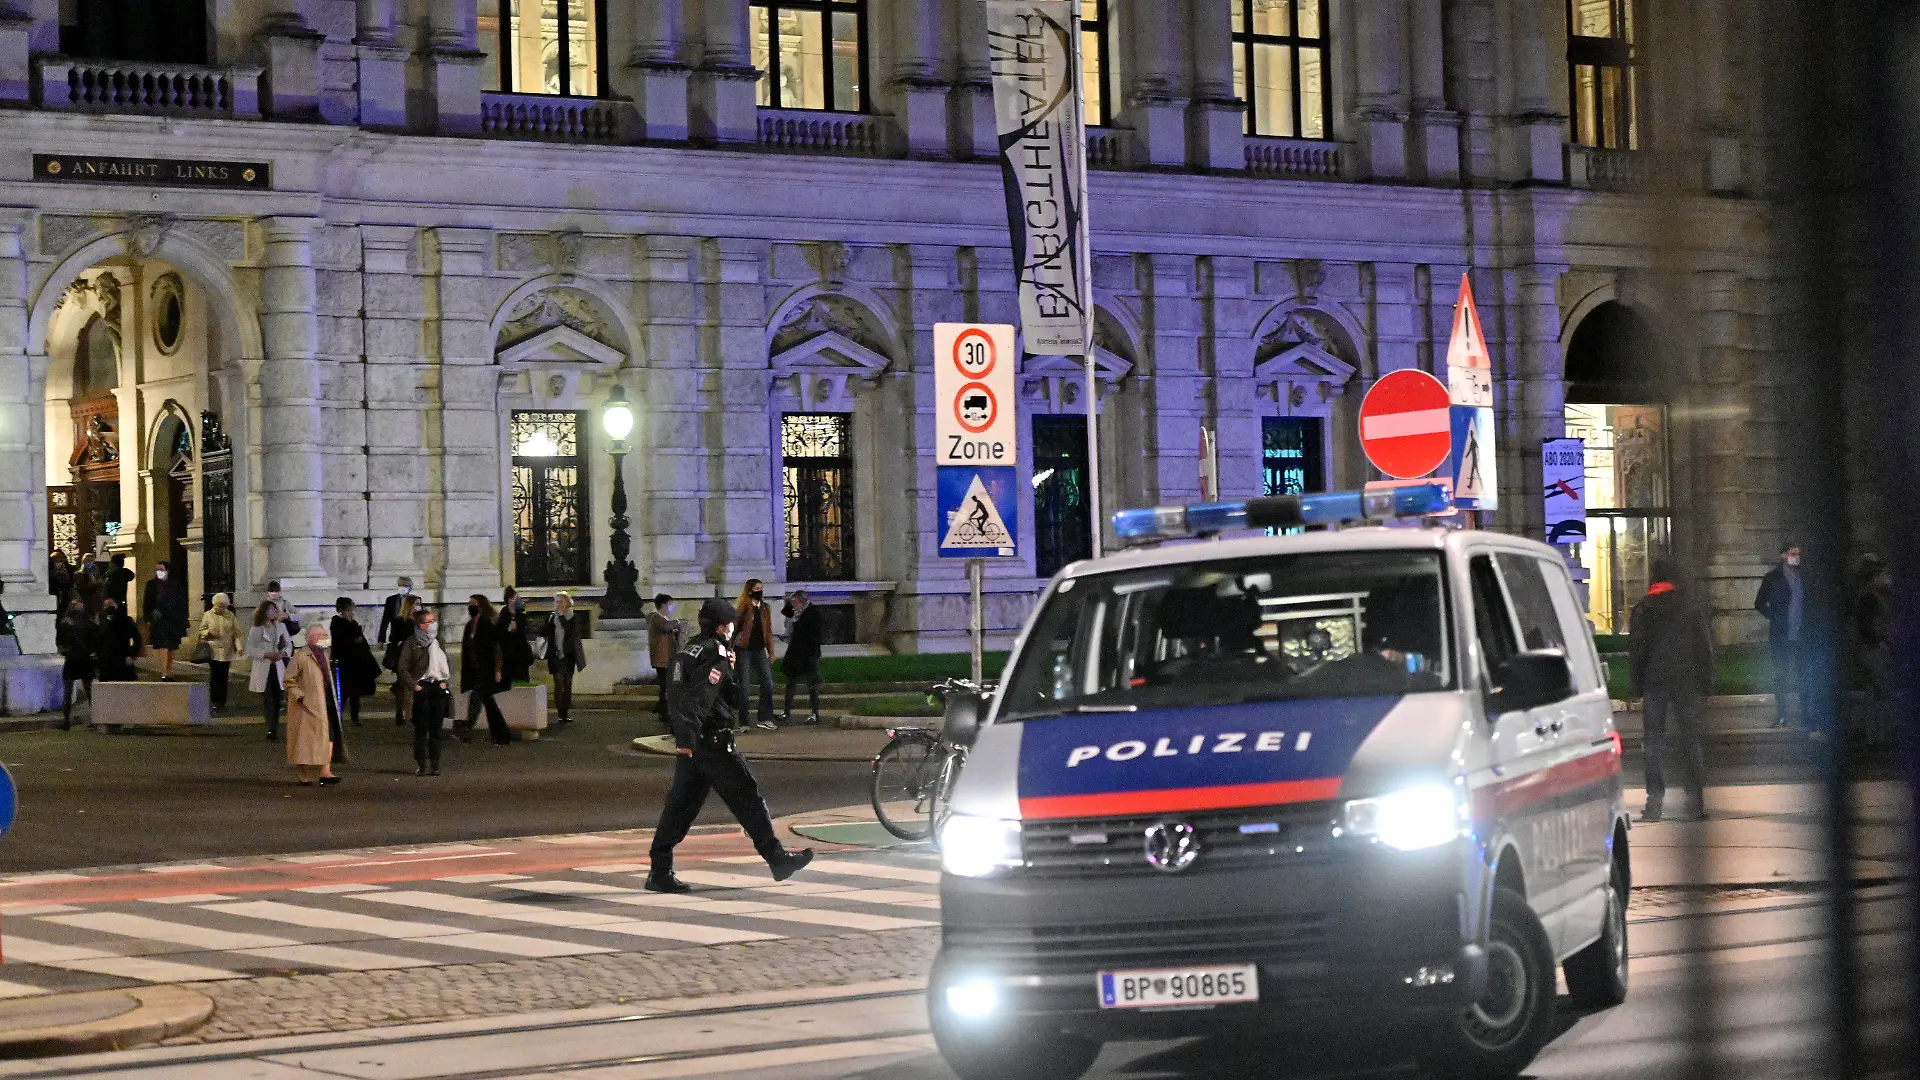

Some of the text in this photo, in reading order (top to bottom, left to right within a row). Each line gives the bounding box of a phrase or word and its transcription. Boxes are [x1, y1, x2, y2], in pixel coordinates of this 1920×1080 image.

[71, 161, 229, 180] ANFAHRT LINKS
[965, 342, 985, 366] 30
[948, 435, 1004, 460] Zone
[1544, 451, 1558, 466] ABO
[1066, 731, 1312, 767] POLIZEI
[1123, 971, 1247, 1001] BP 90865
